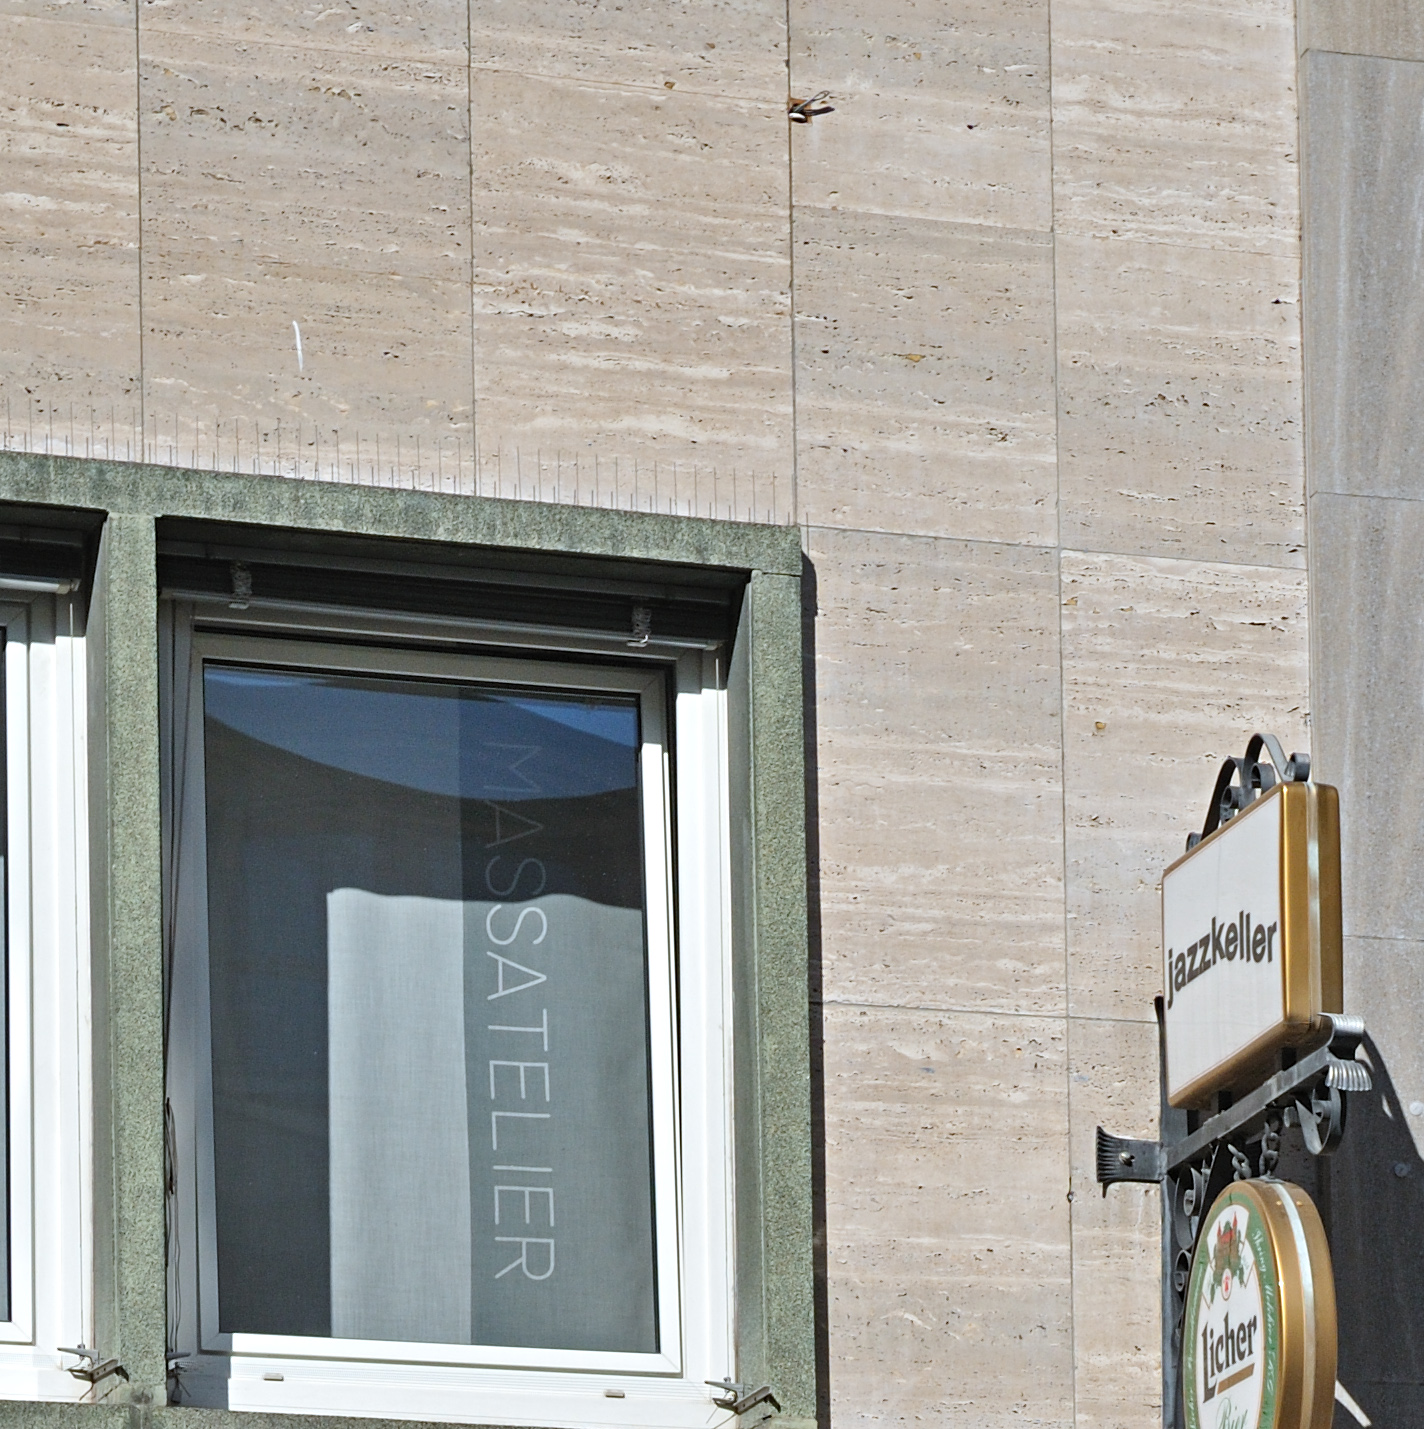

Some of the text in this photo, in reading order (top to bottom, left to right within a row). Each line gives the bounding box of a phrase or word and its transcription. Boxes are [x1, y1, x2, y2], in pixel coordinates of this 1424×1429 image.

[1167, 910, 1277, 1010] jazzkeller
[483, 741, 556, 1280] MASSATELIER
[1201, 1311, 1257, 1404] Licher
